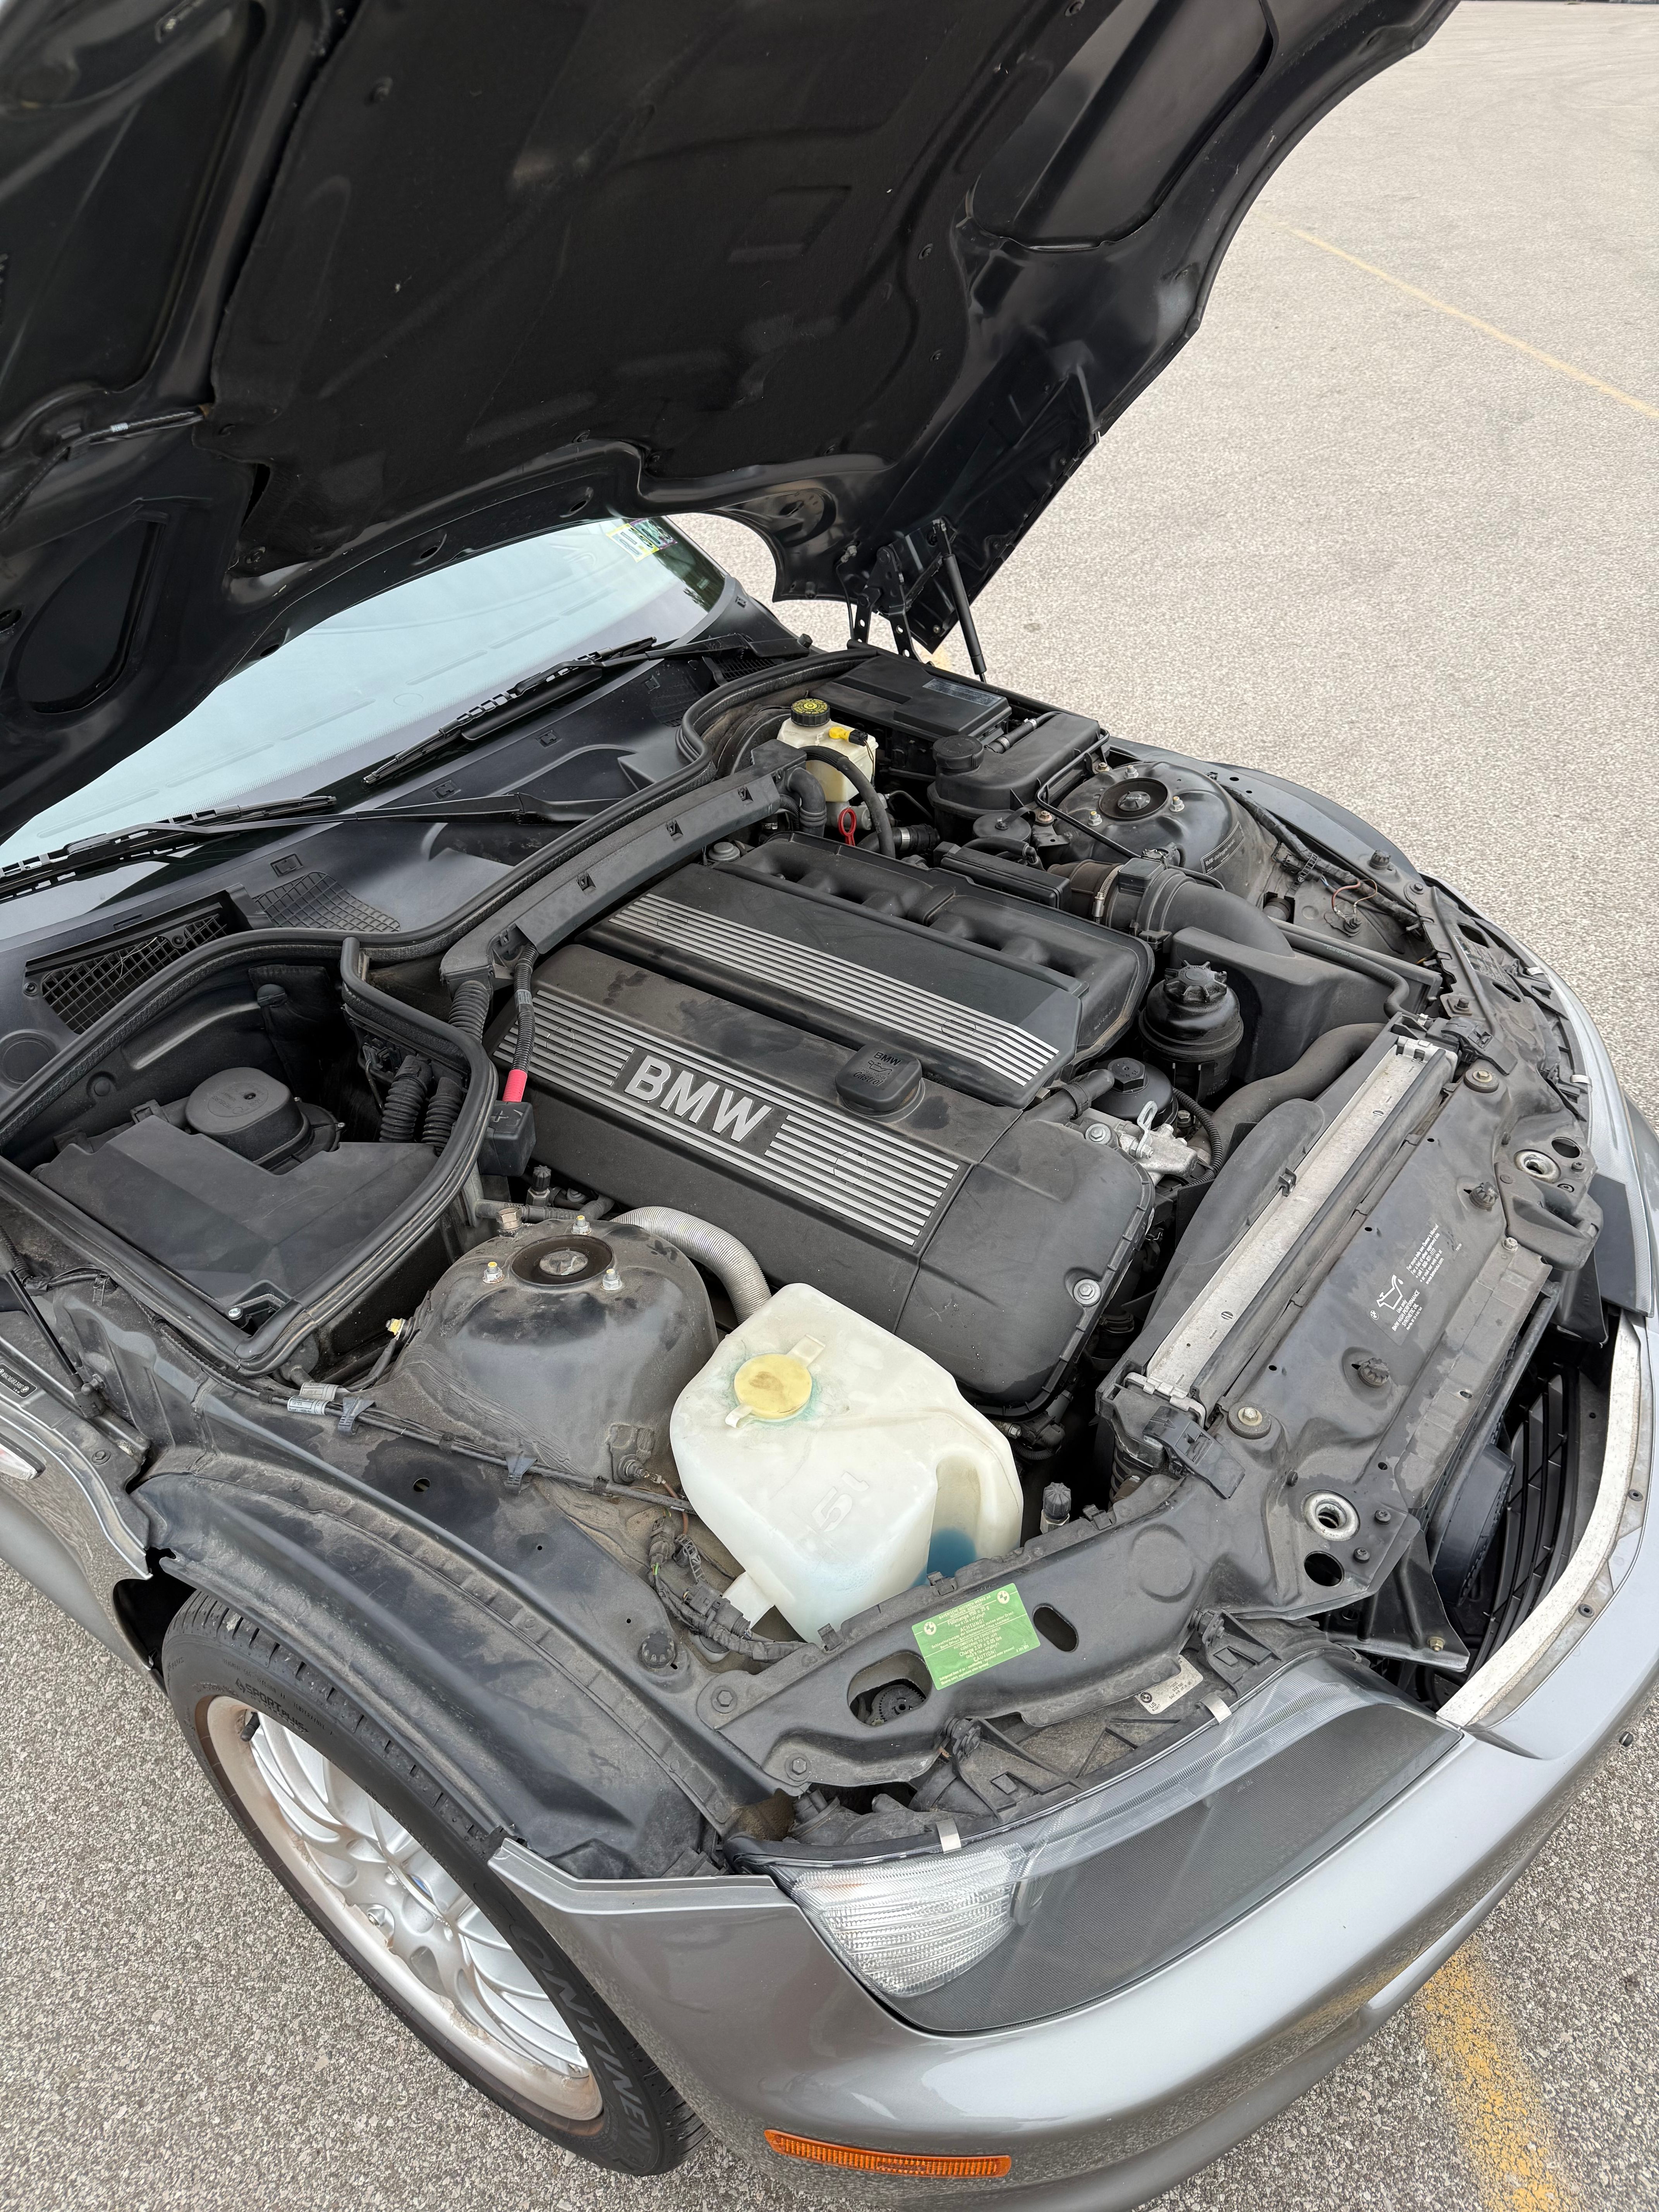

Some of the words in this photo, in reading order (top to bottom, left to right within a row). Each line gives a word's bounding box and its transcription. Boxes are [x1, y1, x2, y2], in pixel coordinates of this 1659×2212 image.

[874, 1051, 901, 1066] BMW
[854, 1072, 884, 1086] Castrol
[624, 1054, 773, 1143] BMW
[1422, 1233, 1432, 1247] Owner's
[1429, 1224, 1439, 1235] Manual
[1425, 1237, 1437, 1252] approved
[1400, 1298, 1408, 1307] only
[1391, 1321, 1400, 1331] BMW
[1396, 1313, 1405, 1322] HIGH
[1401, 1290, 1420, 1315] PERFORMANCE
[1401, 1307, 1416, 1327] SYNTHETIC
[938, 1608, 958, 1619] BAYERISCHE
[958, 1601, 974, 1611] MOTOREN
[947, 1613, 969, 1626] Füllmenge
[959, 1618, 984, 1632] ACHTUNG!
[953, 1638, 974, 1649] AUTOMOTIVE
[979, 1626, 1001, 1638] CONDITIONER
[959, 1647, 974, 1657] Charge
[960, 1641, 978, 1650] CONFORMS
[973, 1649, 996, 1662] CAUTION!
